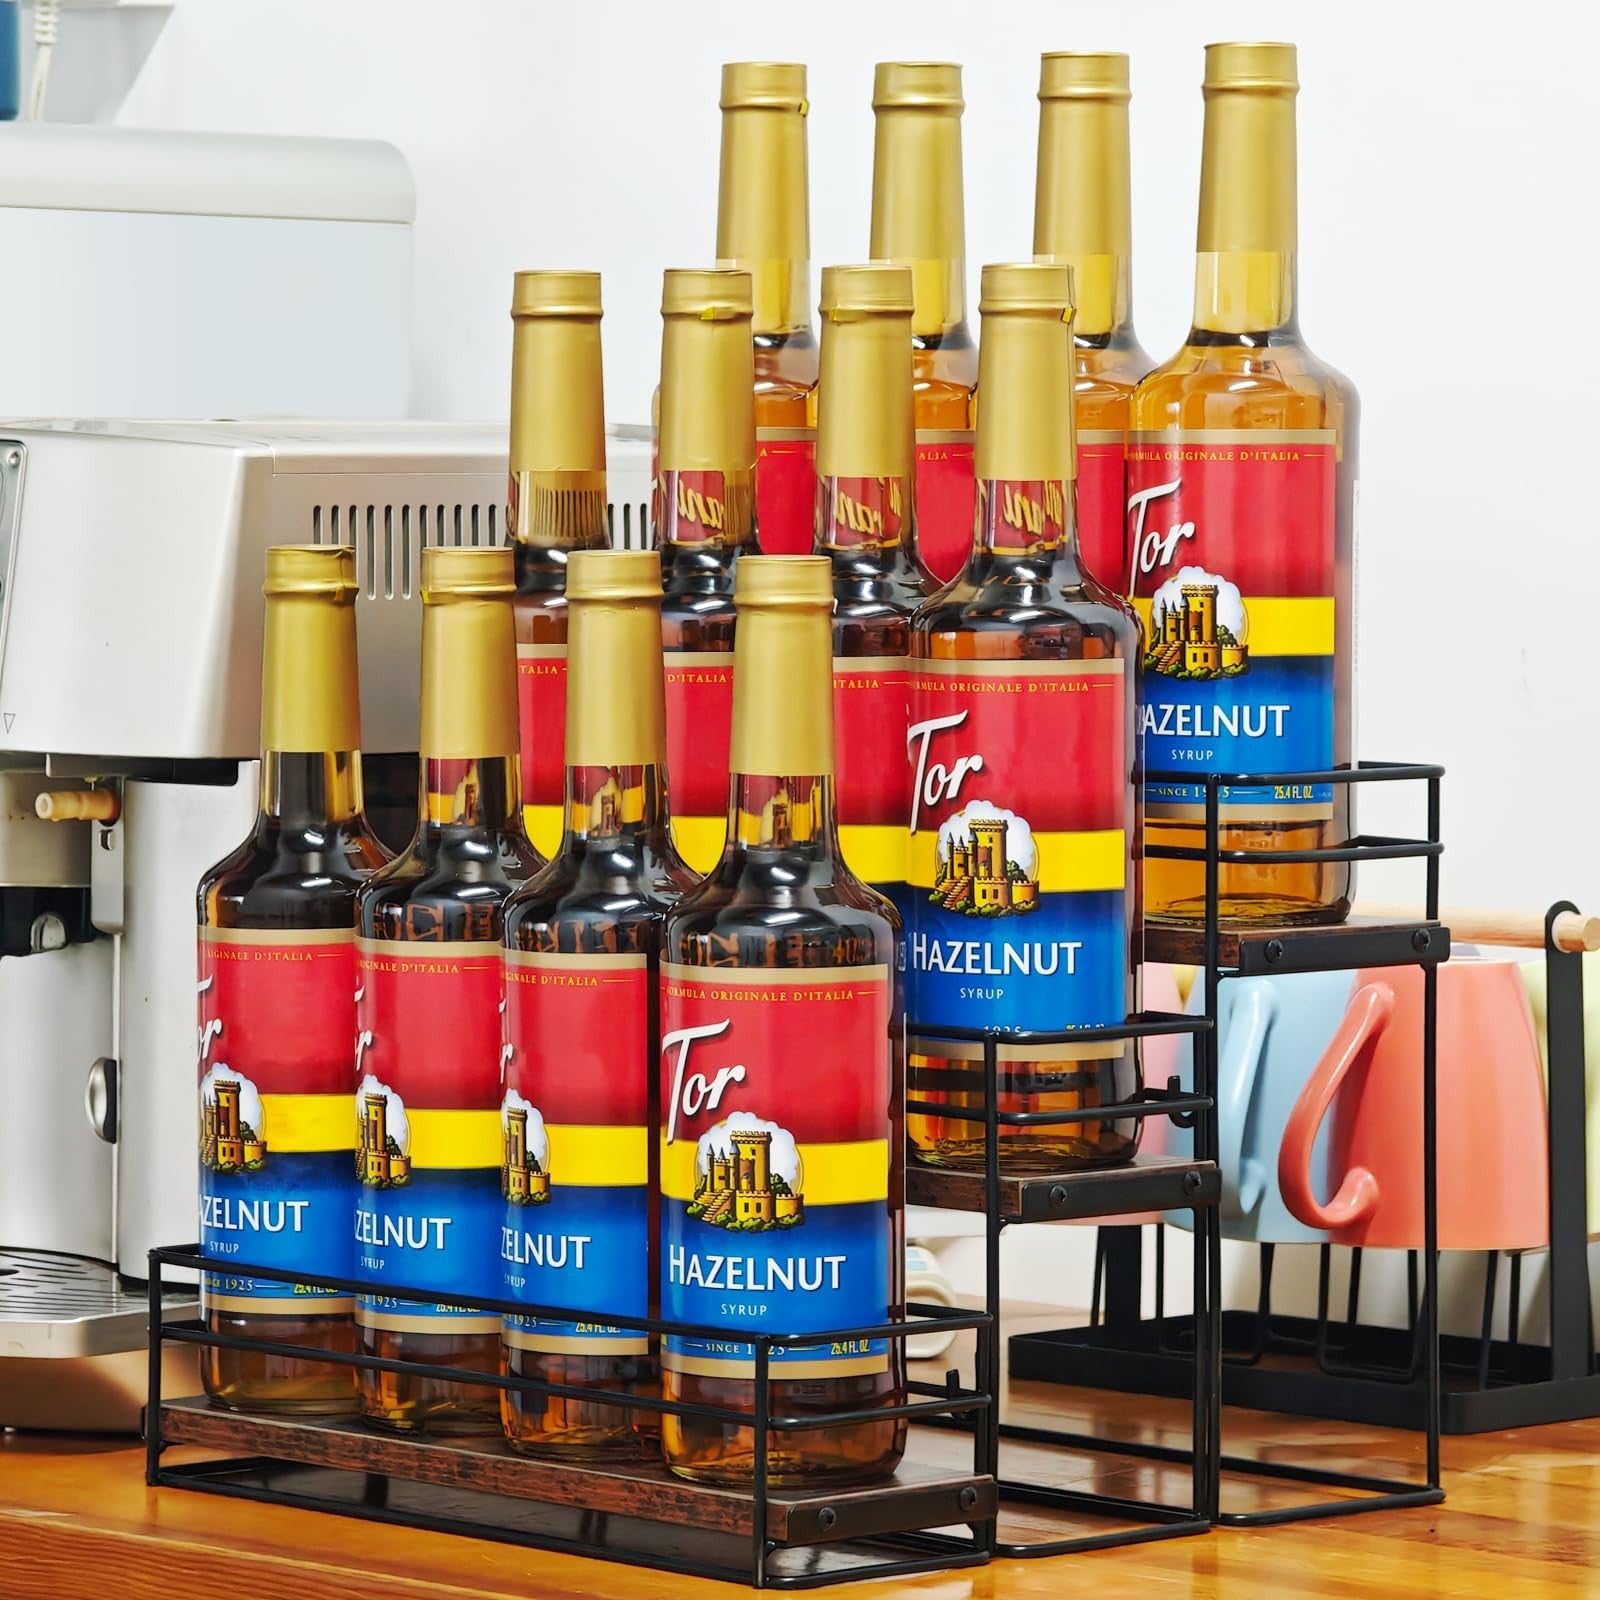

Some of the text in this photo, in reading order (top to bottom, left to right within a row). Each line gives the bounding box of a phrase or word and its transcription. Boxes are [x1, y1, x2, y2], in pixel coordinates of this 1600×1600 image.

[1239, 451, 1300, 461] D'ITALIA
[1127, 477, 1196, 602] Tor
[519, 665, 559, 675] TALIA
[667, 674, 727, 683] D'ITALIA
[833, 679, 879, 689] ITALIA
[911, 680, 1090, 693] MULA ORIGINALE D'ITALIA
[1140, 703, 1291, 738] AZELNUT
[1171, 749, 1214, 761] SYRUP
[906, 708, 984, 837] Tor
[1159, 787, 1188, 797] SINCE
[1193, 786, 1230, 798] 195
[1274, 786, 1291, 799] 25.4
[254, 951, 313, 961] D'ITALIA
[912, 931, 1083, 976] HAZELNUT
[401, 963, 459, 973] D'ITALIA
[504, 971, 599, 987] GINALE D'ITALIA
[711, 990, 787, 1001] ORIGINALE
[793, 990, 854, 1002] D'ITALIA
[960, 987, 1004, 1000] SYRUP
[661, 1017, 747, 1146] Tor
[200, 1193, 310, 1232] ZELNUT
[210, 1240, 239, 1253] SYRUP
[360, 1256, 385, 1270] SYRUP
[668, 1243, 847, 1291] HAZELNUT
[223, 1278, 253, 1292] 1925
[720, 1303, 768, 1316] SYRUP
[706, 1343, 740, 1354] SINCE
[746, 1343, 785, 1356] 125
